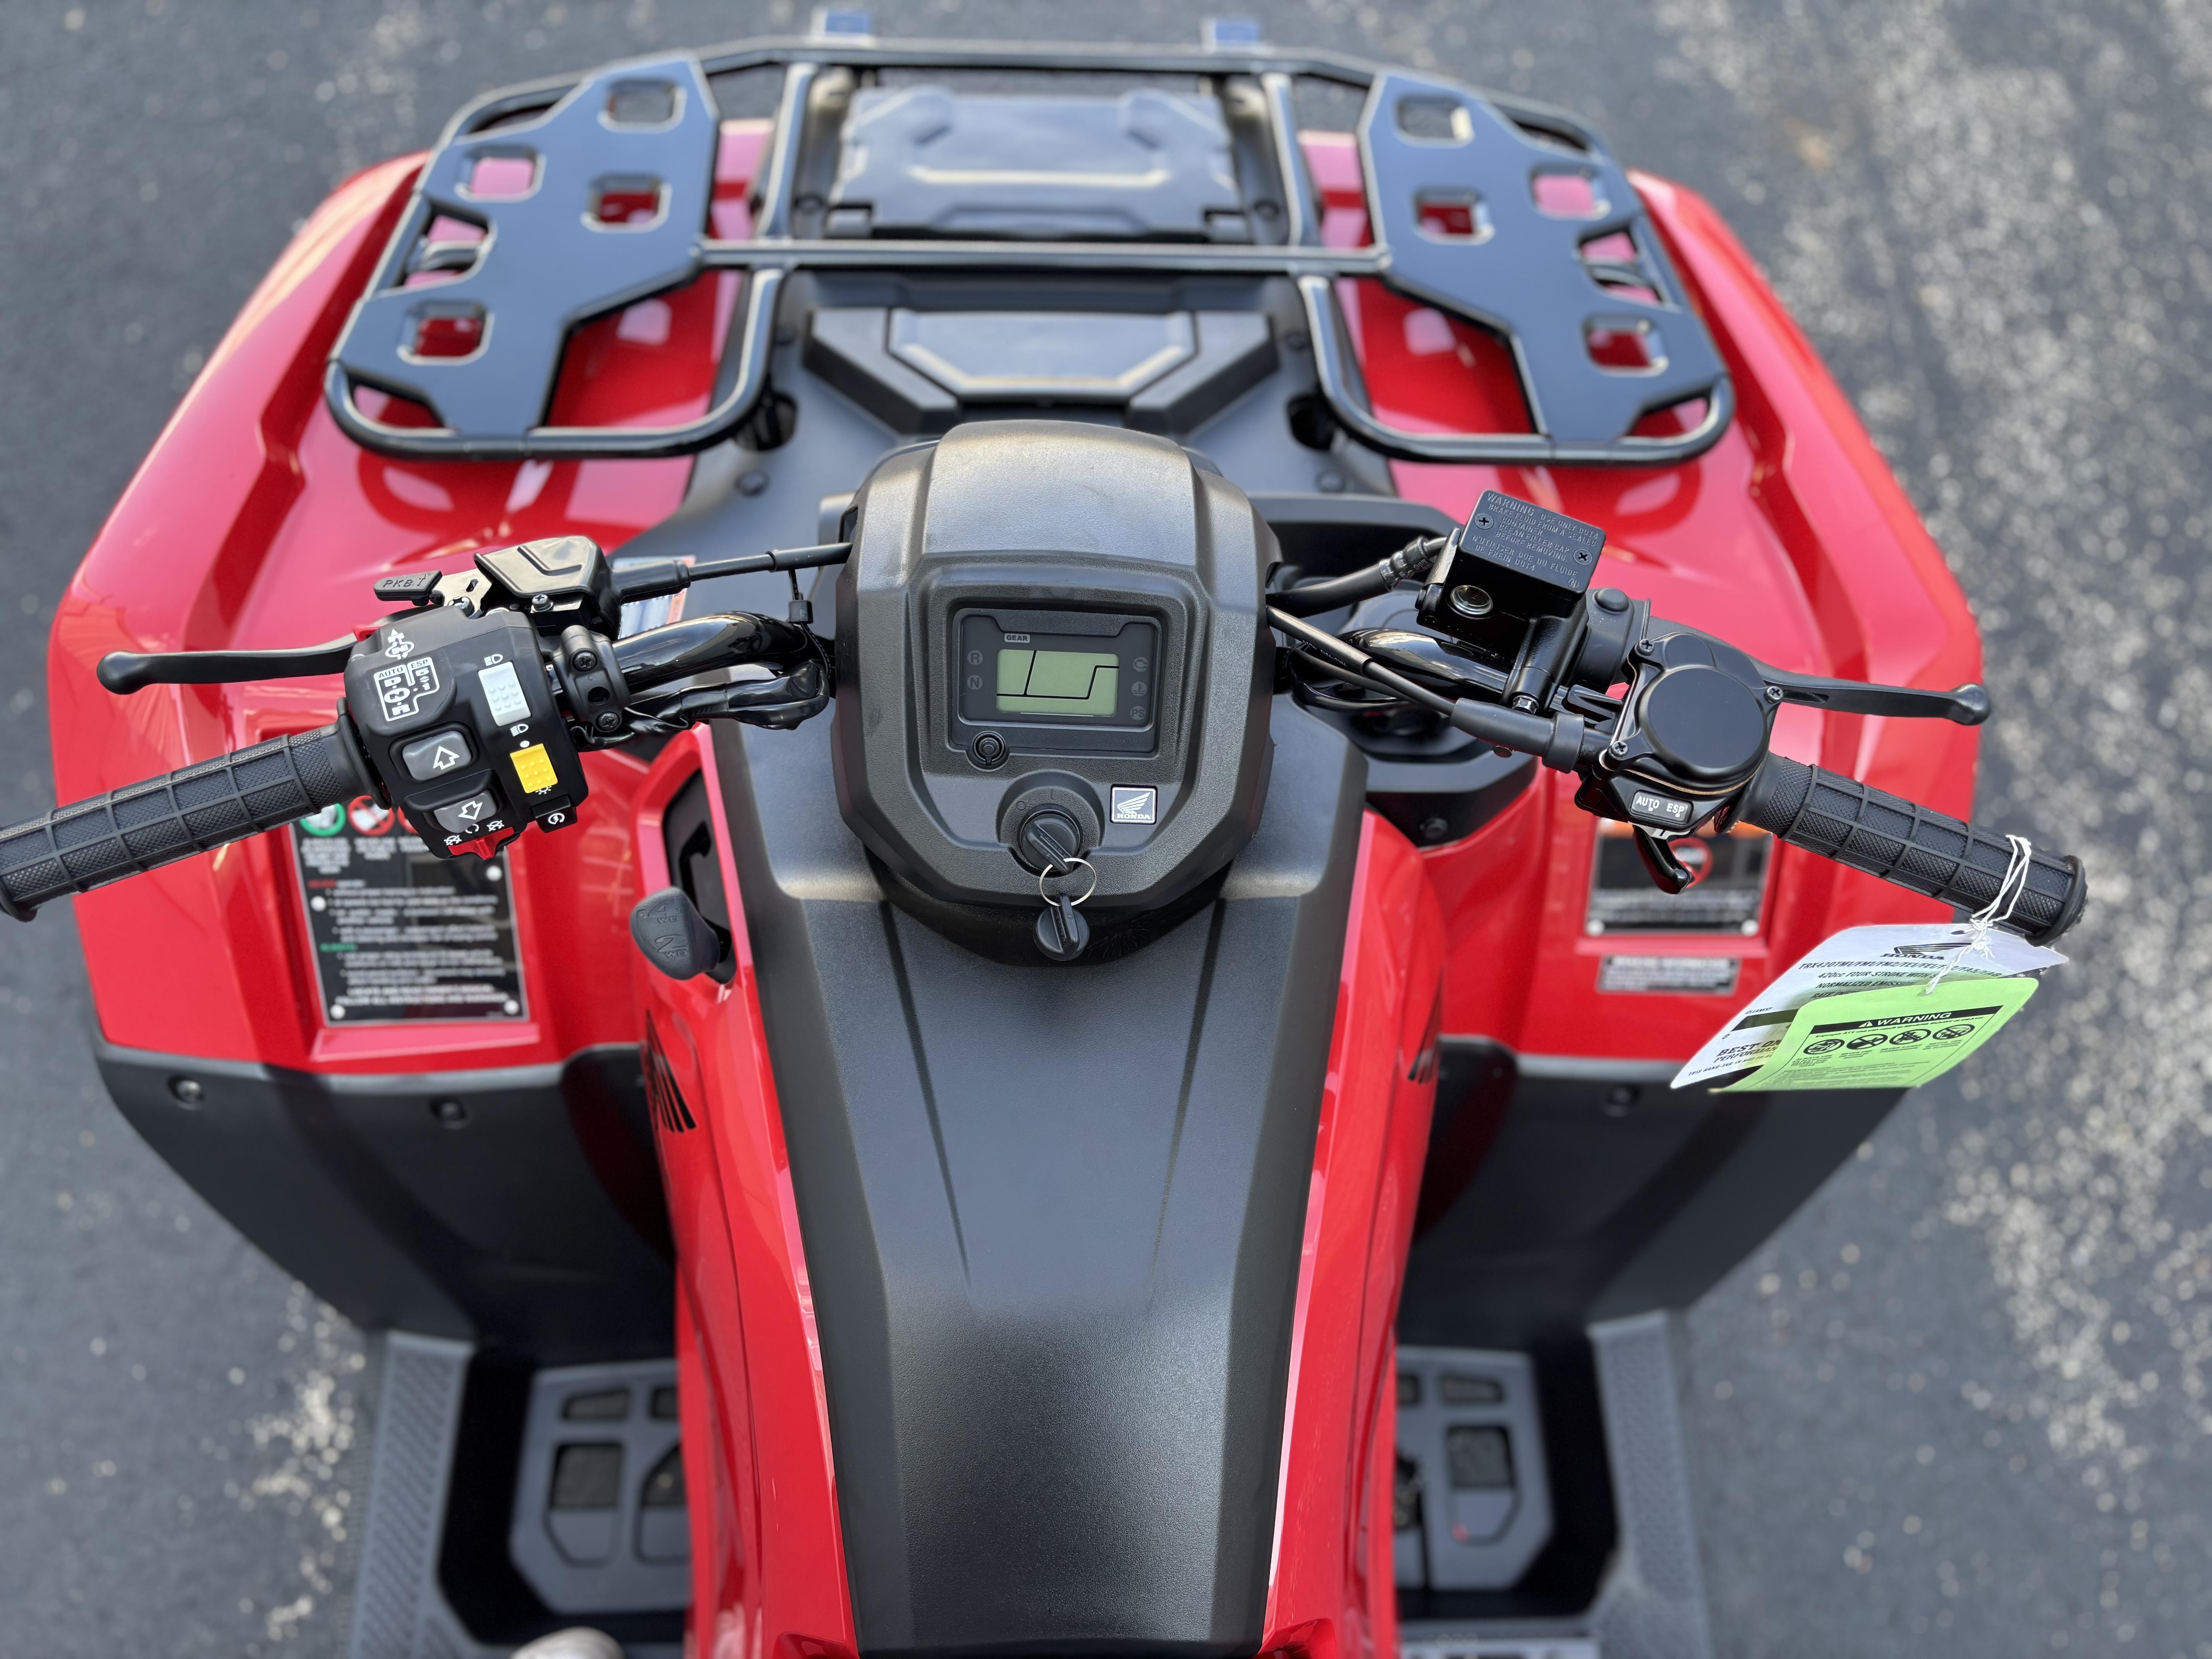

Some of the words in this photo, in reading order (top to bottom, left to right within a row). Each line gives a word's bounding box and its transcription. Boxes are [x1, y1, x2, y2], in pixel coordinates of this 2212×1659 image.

[1487, 493, 1534, 516] WARNING
[1541, 514, 1556, 524] USE
[1558, 520, 1577, 531] ONLY
[1488, 503, 1514, 517] BRAKE
[1515, 513, 1536, 524] FLUID
[1537, 521, 1558, 533] FROM
[1568, 531, 1596, 546] SEALED
[1502, 517, 1543, 536] CONTAINER
[1495, 531, 1525, 546] BEFORE
[1499, 524, 1525, 537] CLEAN
[1525, 534, 1553, 548] FILLER
[1475, 545, 1486, 553] DE
[1488, 549, 1511, 562] FREIN
[1536, 558, 1547, 566] DU
[1550, 563, 1577, 578] FLUIDE
[383, 579, 413, 587] PKB
[411, 659, 428, 668] ESP
[970, 652, 980, 663] R
[379, 667, 403, 679] AUTO
[384, 677, 402, 687] D
[970, 677, 979, 688] N
[390, 691, 405, 700] N
[392, 704, 410, 716] R
[1132, 709, 1145, 718] PS
[1636, 796, 1660, 809] AUTO
[1666, 803, 1685, 814] ESP
[1877, 1012, 1952, 1025] WARNING
[1713, 1046, 1778, 1063] PERFORMAN
[1716, 1042, 1761, 1056] BEST
